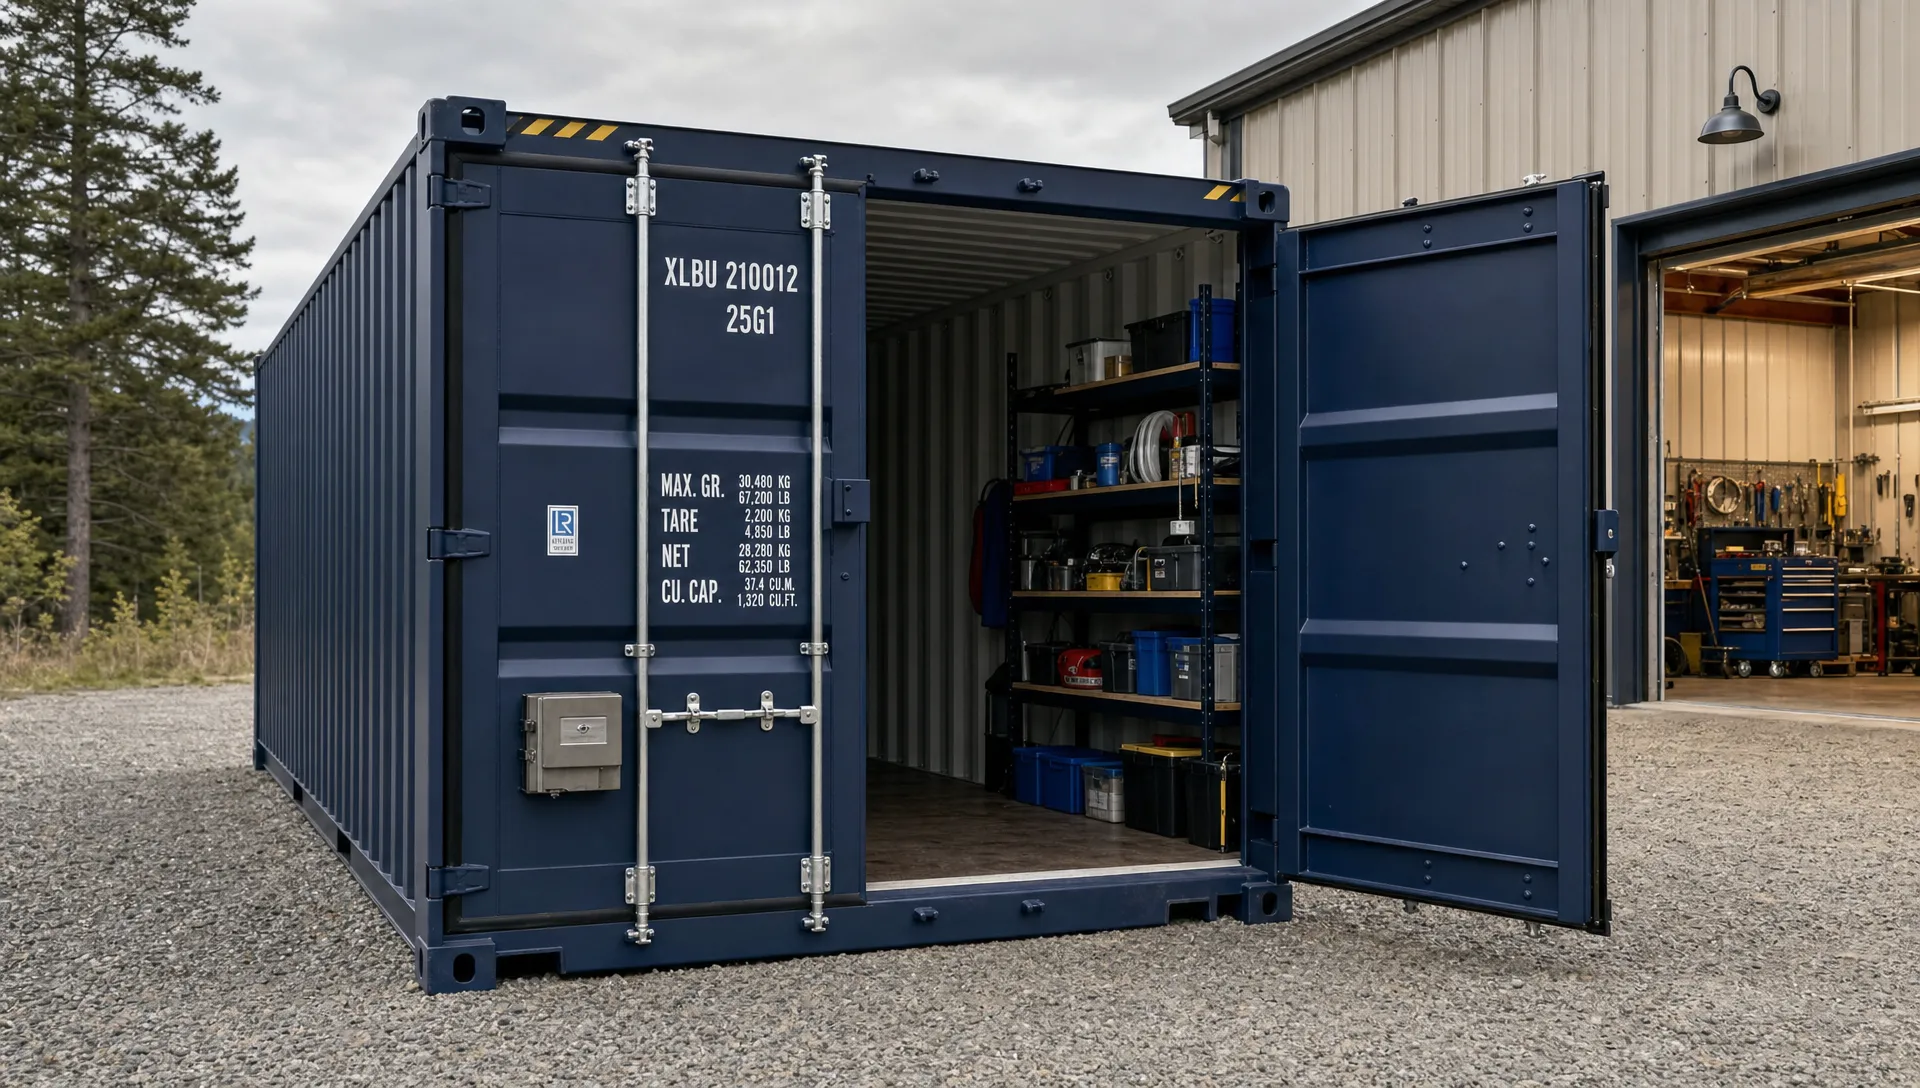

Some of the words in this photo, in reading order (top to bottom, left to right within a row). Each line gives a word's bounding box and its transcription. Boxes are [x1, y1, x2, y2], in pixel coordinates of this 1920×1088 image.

[665, 256, 718, 289] XLBU
[725, 261, 798, 293] 210012
[726, 304, 774, 335] 25G1
[661, 473, 697, 498] MAX.
[701, 474, 725, 498] GR.
[738, 474, 773, 489] 30,480
[778, 474, 791, 489] KG
[738, 491, 773, 505] 67,200
[778, 491, 790, 505] LB
[555, 510, 573, 534] LR
[661, 508, 699, 533] TARE
[744, 508, 773, 523] 2,200
[778, 508, 791, 523] KG
[744, 525, 773, 539] 4,850
[778, 525, 790, 539] LB
[662, 544, 690, 568] NET
[738, 543, 773, 558] 28,280
[778, 543, 791, 558] KG
[738, 560, 773, 574] 62,350
[778, 560, 790, 574] LB
[661, 579, 686, 604] CU.
[689, 579, 722, 604] CAP.
[744, 577, 765, 591] 37.4
[769, 577, 795, 591] CU.M.
[737, 593, 764, 608] 1,320
[769, 593, 798, 607] CU.FT.
